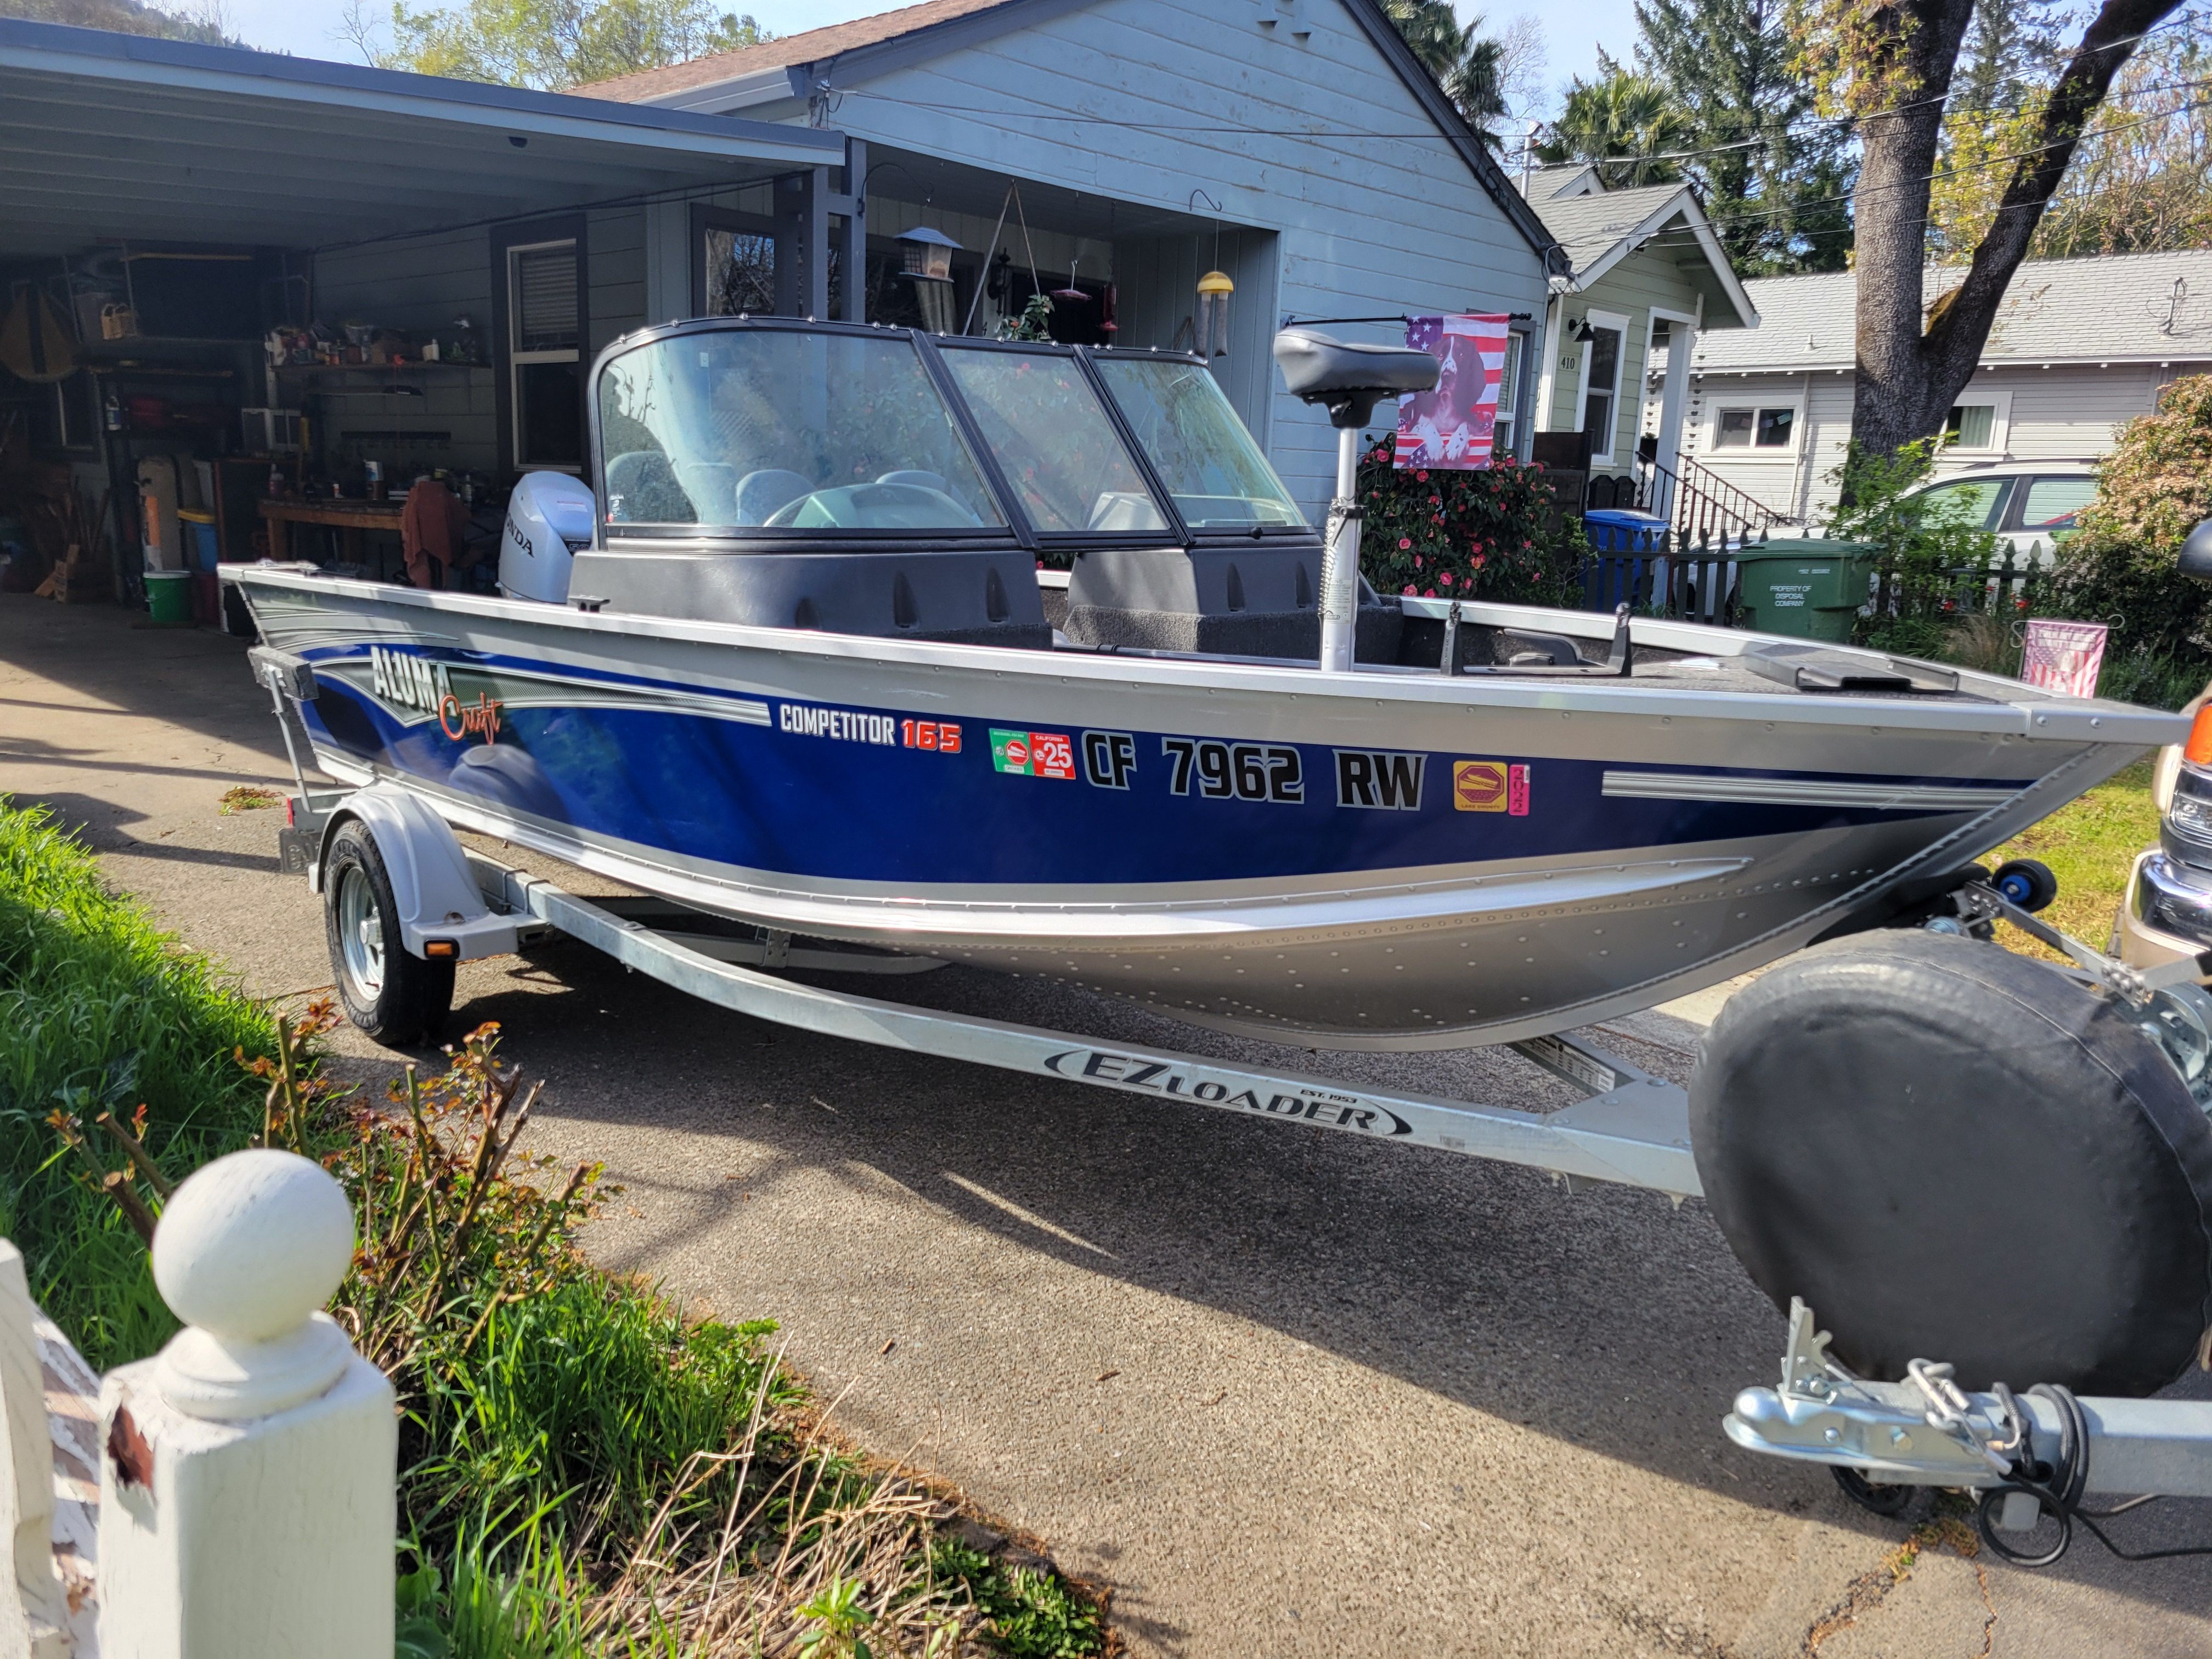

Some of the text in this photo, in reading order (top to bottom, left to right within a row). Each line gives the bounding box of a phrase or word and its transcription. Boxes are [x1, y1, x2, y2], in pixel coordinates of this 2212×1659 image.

[1561, 357, 1575, 370] 410
[780, 703, 962, 754] COMPETITOR 165
[1043, 742, 1072, 769] 25
[1082, 730, 1428, 811] CF 7962 RW
[1300, 1088, 1358, 1104] EST. 1953
